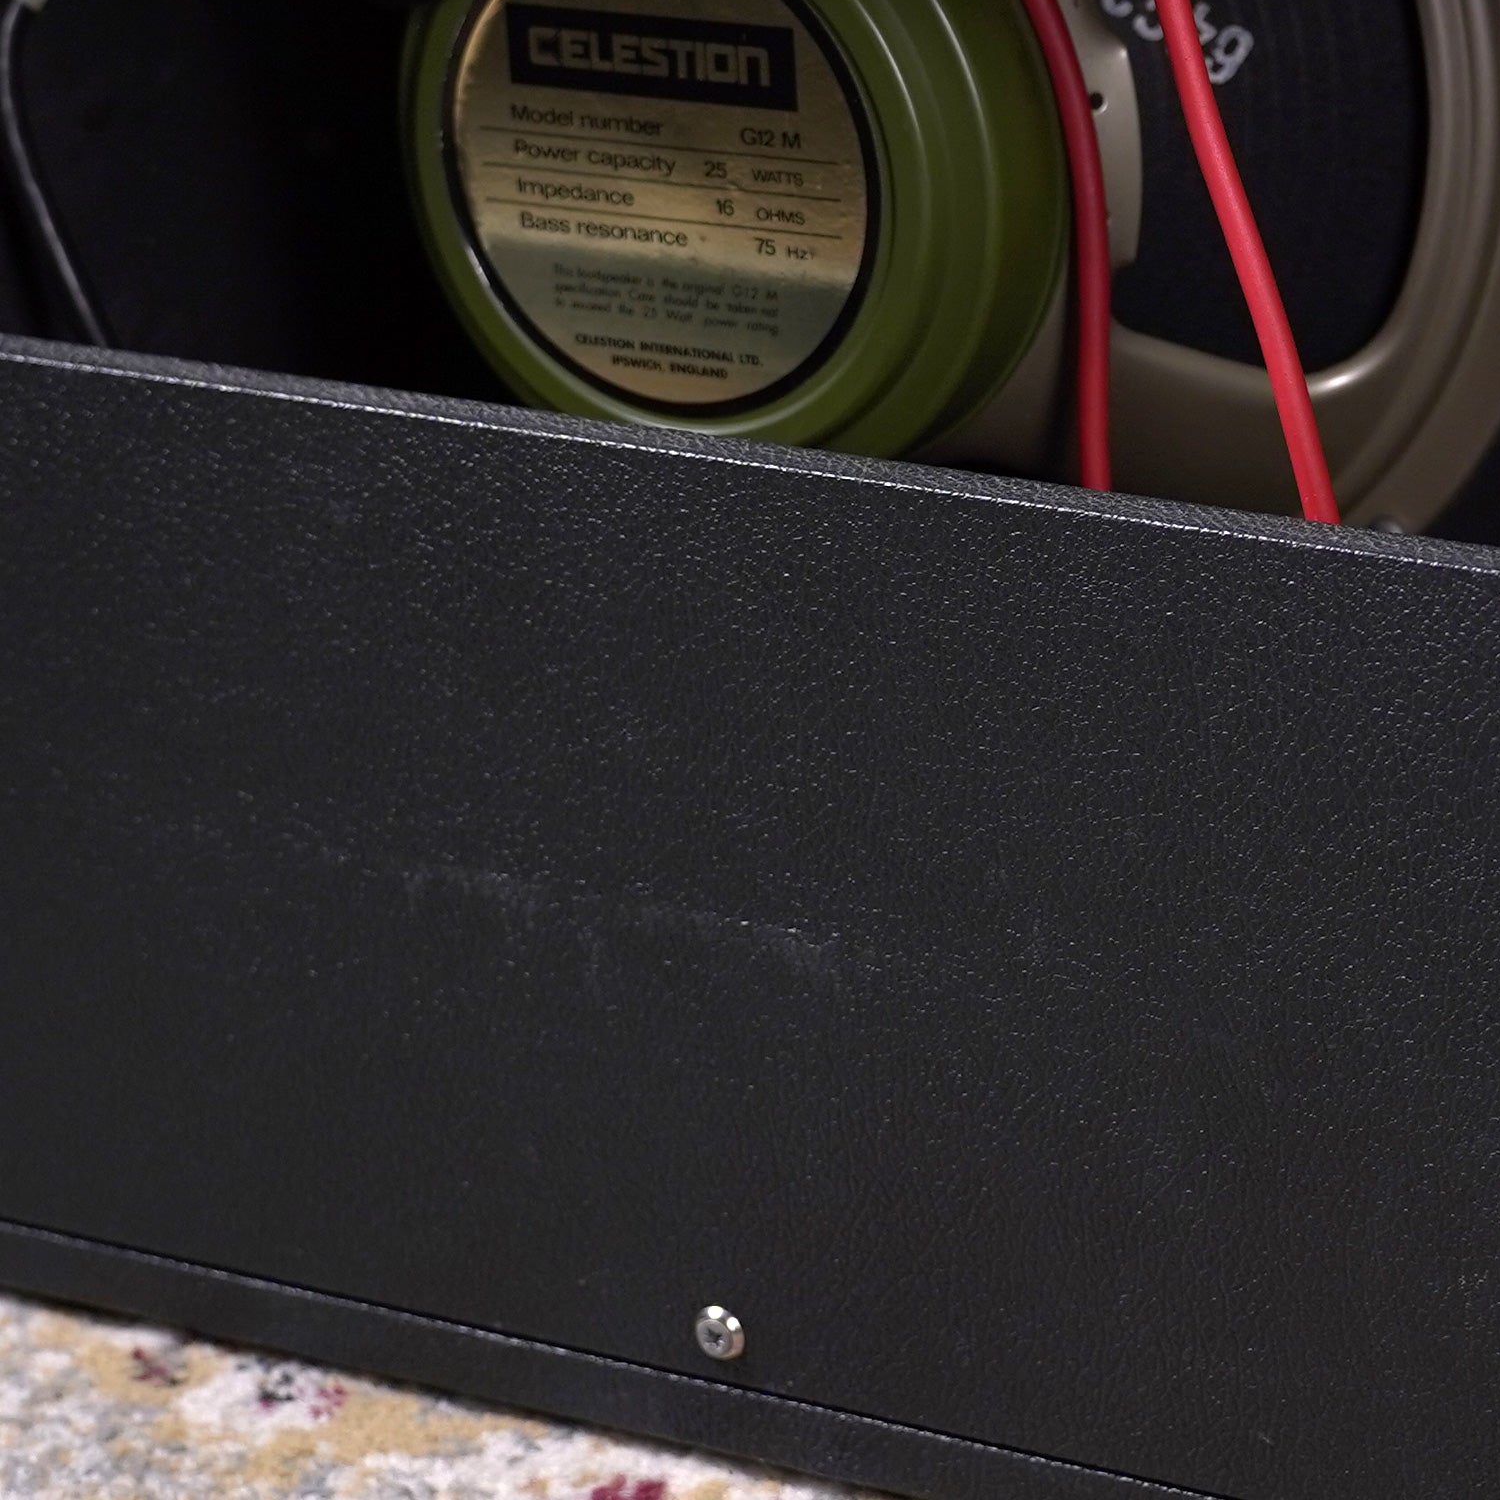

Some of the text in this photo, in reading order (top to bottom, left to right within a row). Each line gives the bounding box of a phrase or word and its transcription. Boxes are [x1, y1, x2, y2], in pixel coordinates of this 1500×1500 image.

[528, 26, 771, 87] CELESTION
[510, 103, 801, 150] Model number G12 M
[513, 138, 804, 188] Power capacity 25 WATTS
[517, 176, 806, 226] Impedance 16 OHMS
[519, 210, 809, 261] Bass resonance 75 Hz
[574, 332, 636, 351] CELESTION
[639, 339, 736, 364] INTERNATIONAL
[669, 360, 730, 381] ENGLAND
